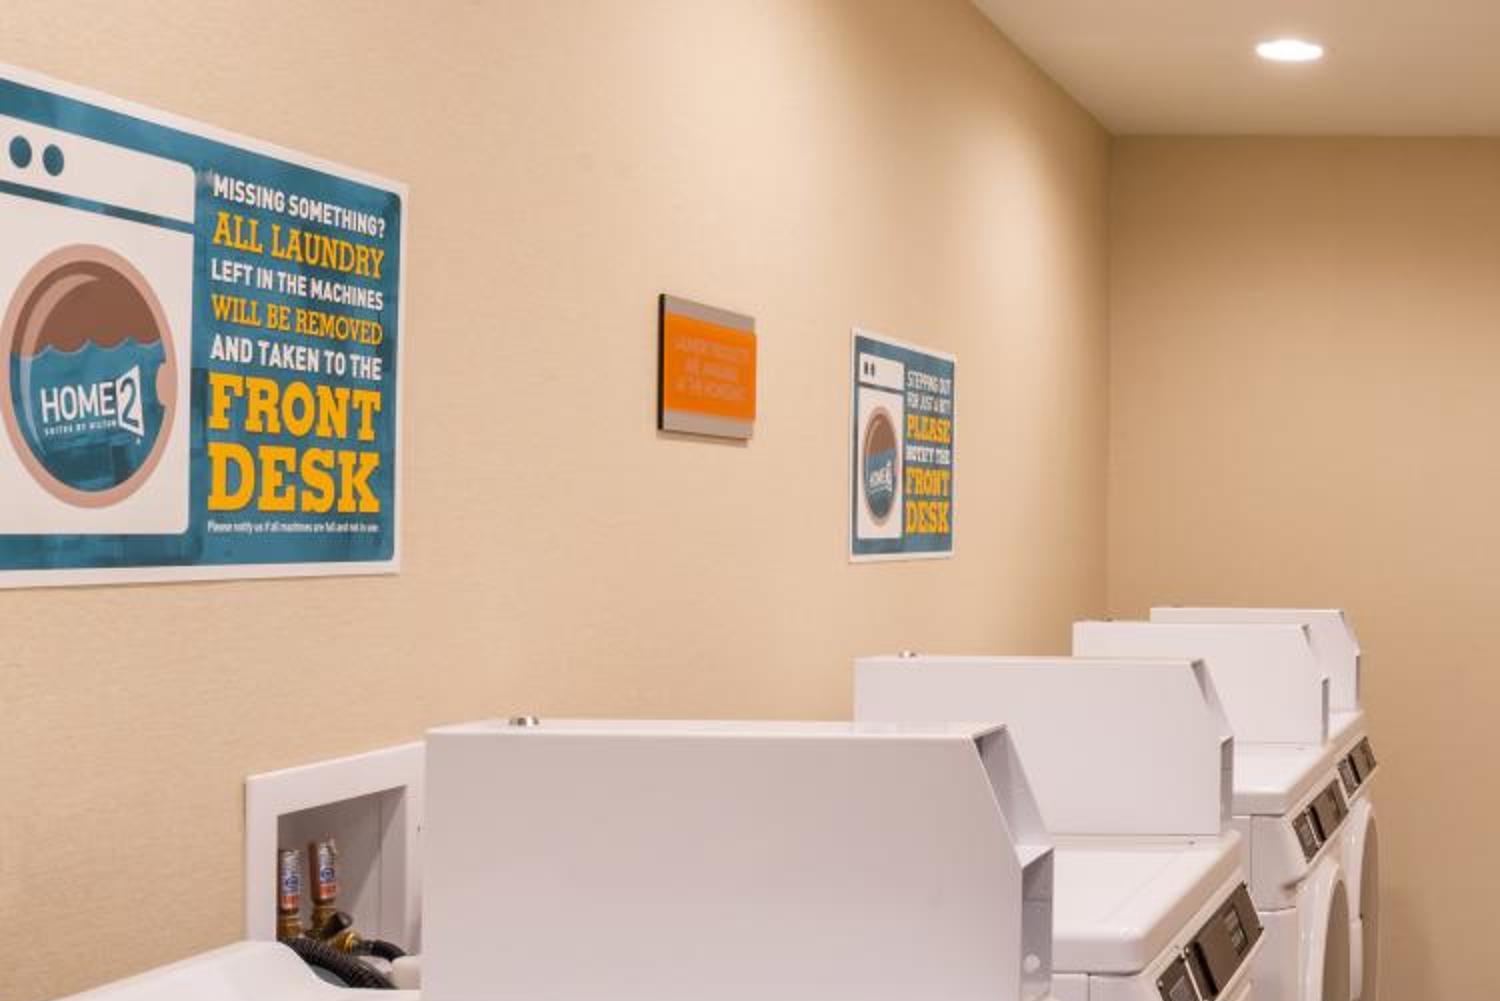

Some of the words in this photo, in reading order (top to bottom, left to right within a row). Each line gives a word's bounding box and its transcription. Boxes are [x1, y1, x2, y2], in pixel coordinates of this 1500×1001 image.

[213, 174, 285, 213] MISSING
[288, 195, 385, 238] SOMETHING?
[213, 211, 263, 254] ALL
[271, 224, 384, 279] LAUNDRY
[211, 258, 253, 286] LEFT
[256, 267, 273, 290] IN
[277, 271, 308, 297] THE
[311, 278, 383, 310] MACHINES
[211, 293, 261, 327] WILL
[267, 303, 291, 331] BE
[295, 307, 383, 345] REMOVED
[210, 334, 253, 363] AND
[258, 340, 319, 372] TAKEN
[324, 351, 346, 376] TO
[350, 353, 383, 380] THE
[207, 372, 382, 441] FRONT
[907, 415, 951, 443] PLEASE
[207, 441, 381, 513] DESK
[905, 467, 950, 496] FRONT
[207, 519, 232, 533] Please
[905, 501, 950, 534] DESK
